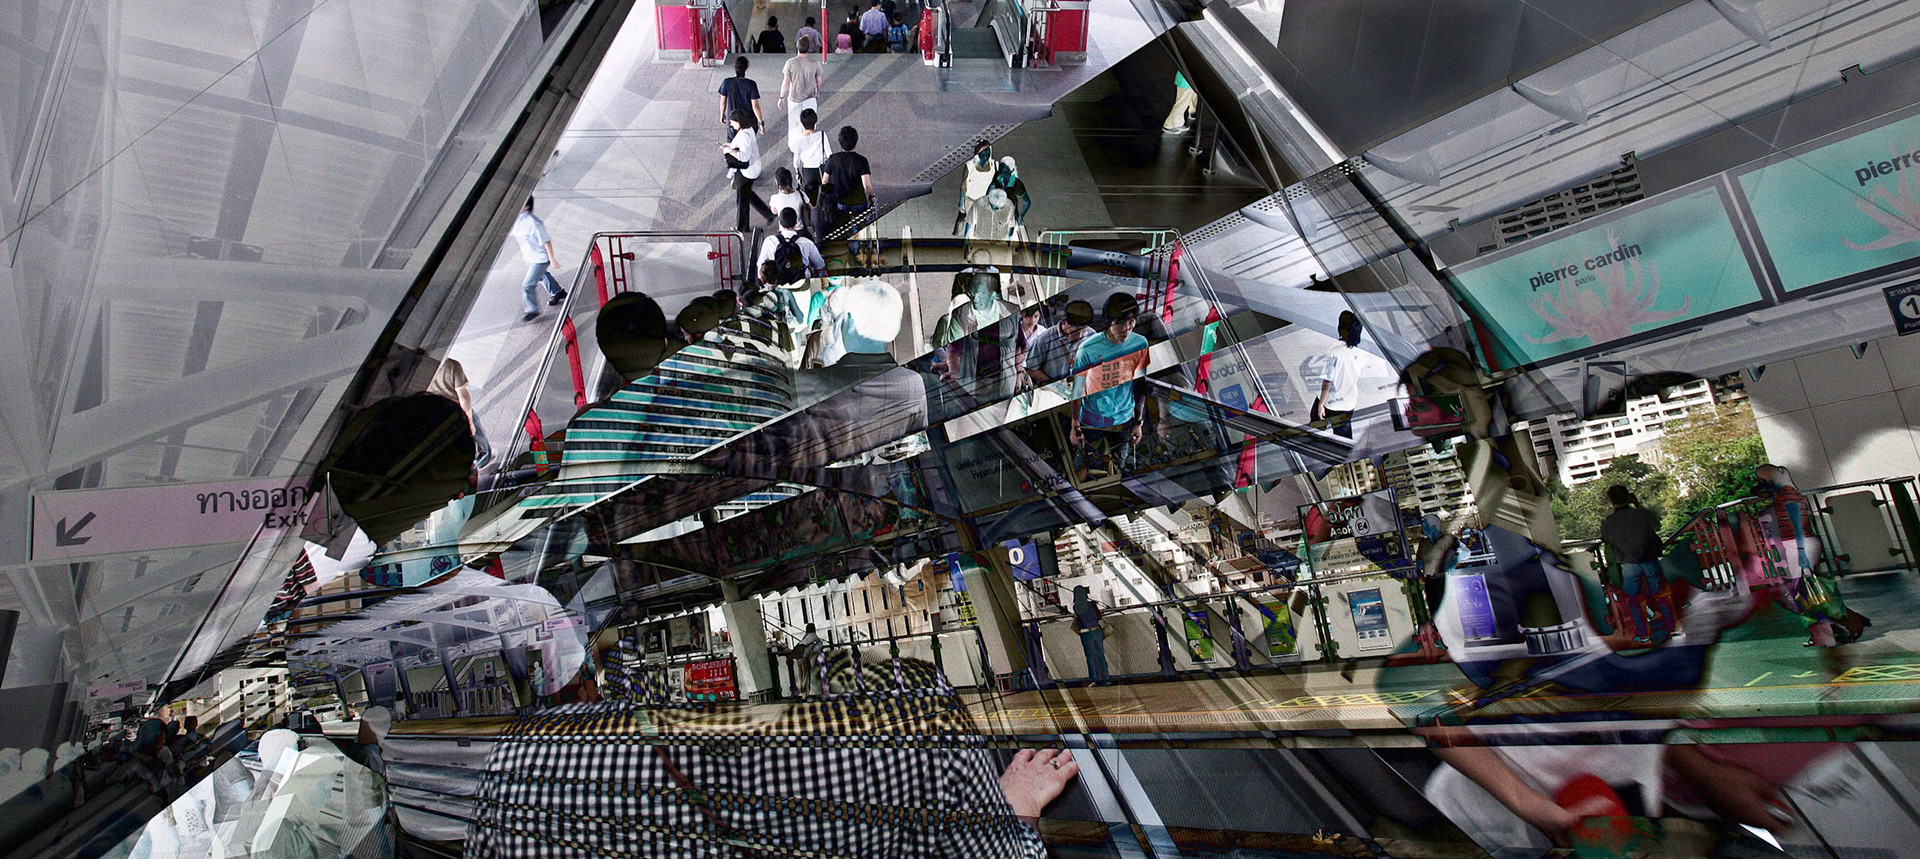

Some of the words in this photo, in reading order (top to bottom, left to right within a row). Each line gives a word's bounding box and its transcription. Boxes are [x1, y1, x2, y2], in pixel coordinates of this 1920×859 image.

[1528, 265, 1580, 292] pierre
[1584, 243, 1643, 271] cardin
[1575, 274, 1596, 287] paris
[1905, 297, 1919, 316] 1
[1222, 390, 1239, 400] NEW
[196, 486, 307, 514] ทางออก
[265, 510, 308, 529] Exit
[1328, 502, 1365, 524] อโศก
[1357, 521, 1368, 532] E4
